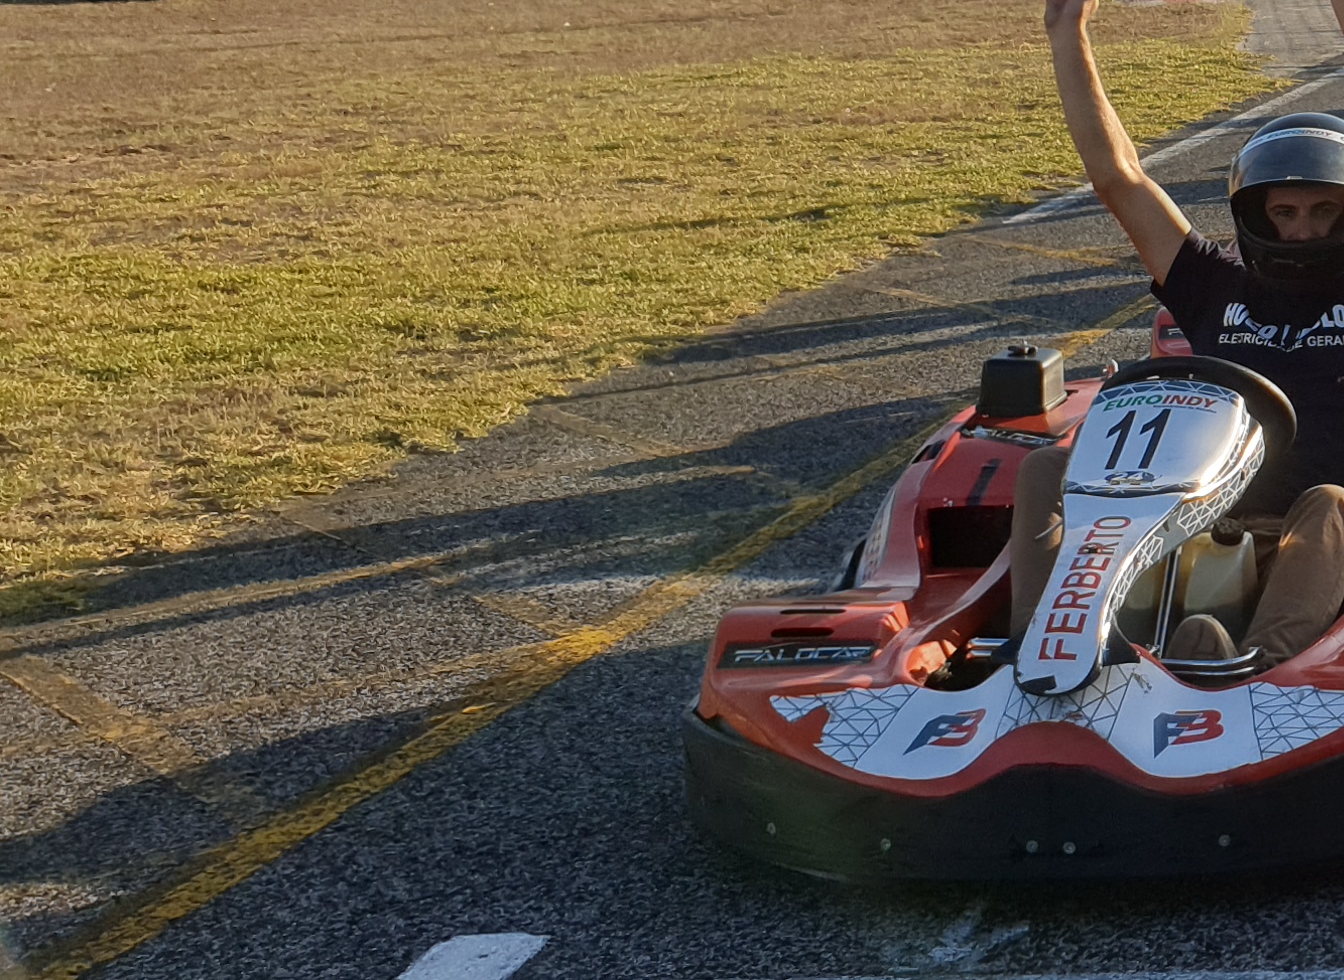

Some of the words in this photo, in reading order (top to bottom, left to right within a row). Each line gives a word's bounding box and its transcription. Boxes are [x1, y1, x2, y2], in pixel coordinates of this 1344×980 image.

[1103, 394, 1218, 412] EUROINDY
[1104, 408, 1171, 471] 11
[1038, 515, 1134, 661] FERBERTO
[733, 646, 873, 664] PALOCAR
